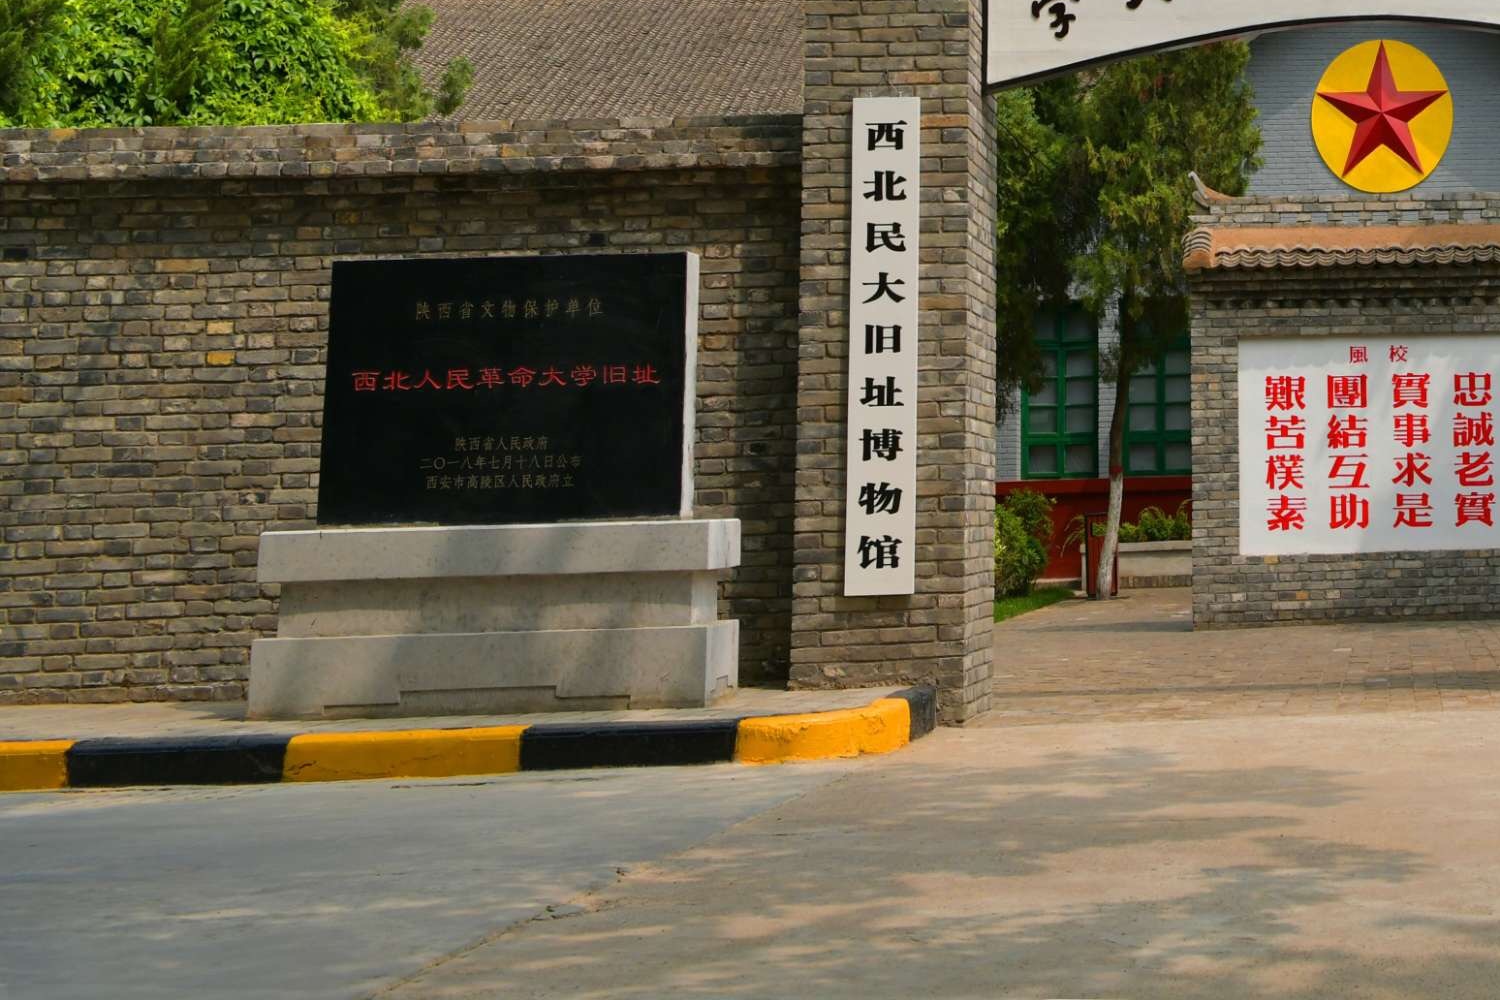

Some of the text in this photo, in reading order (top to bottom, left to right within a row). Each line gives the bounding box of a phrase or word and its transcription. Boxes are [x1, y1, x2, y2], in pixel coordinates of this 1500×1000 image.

[351, 364, 661, 392] 西北人民革命大学旧址
[415, 298, 605, 321] 陕西省文物保护单位
[856, 119, 908, 570] 西北民大旧址博物馆
[425, 474, 576, 490] 西安市高陵区人民政府立
[454, 436, 549, 451] 陕西省人民政府
[1264, 375, 1308, 532] 艱苦樸素
[1326, 374, 1370, 530] 團結互助
[1391, 373, 1434, 529] 實事求是
[1453, 372, 1496, 528] 忠誠老實
